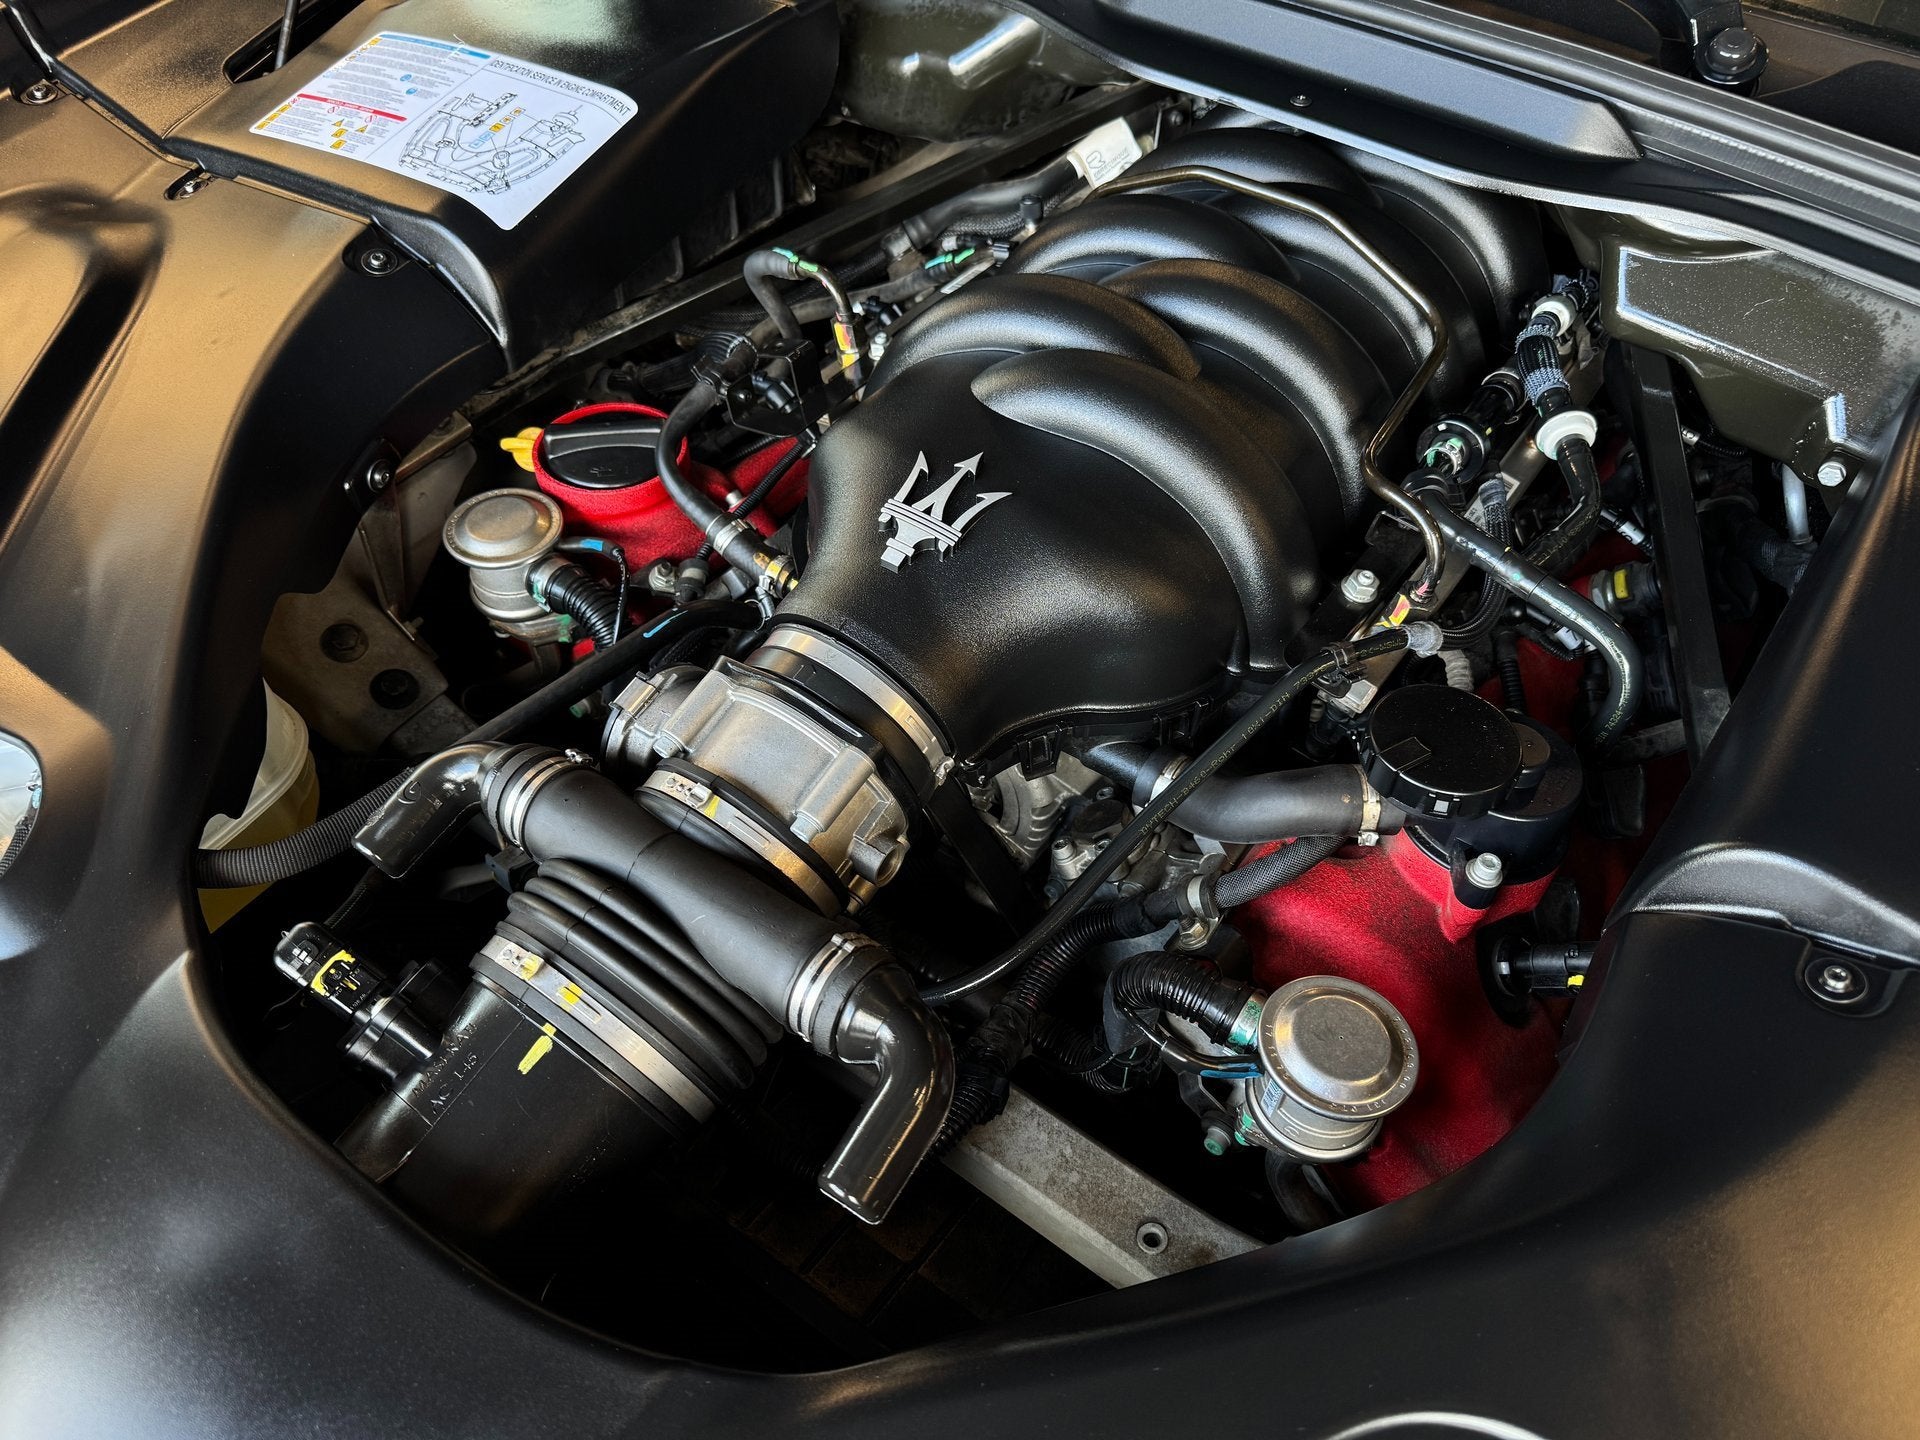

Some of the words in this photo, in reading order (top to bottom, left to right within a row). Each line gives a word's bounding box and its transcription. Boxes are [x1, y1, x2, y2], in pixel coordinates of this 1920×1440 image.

[530, 71, 558, 85] SERVICE
[559, 80, 586, 95] ENGINE
[581, 87, 632, 117] COMPARTMENT
